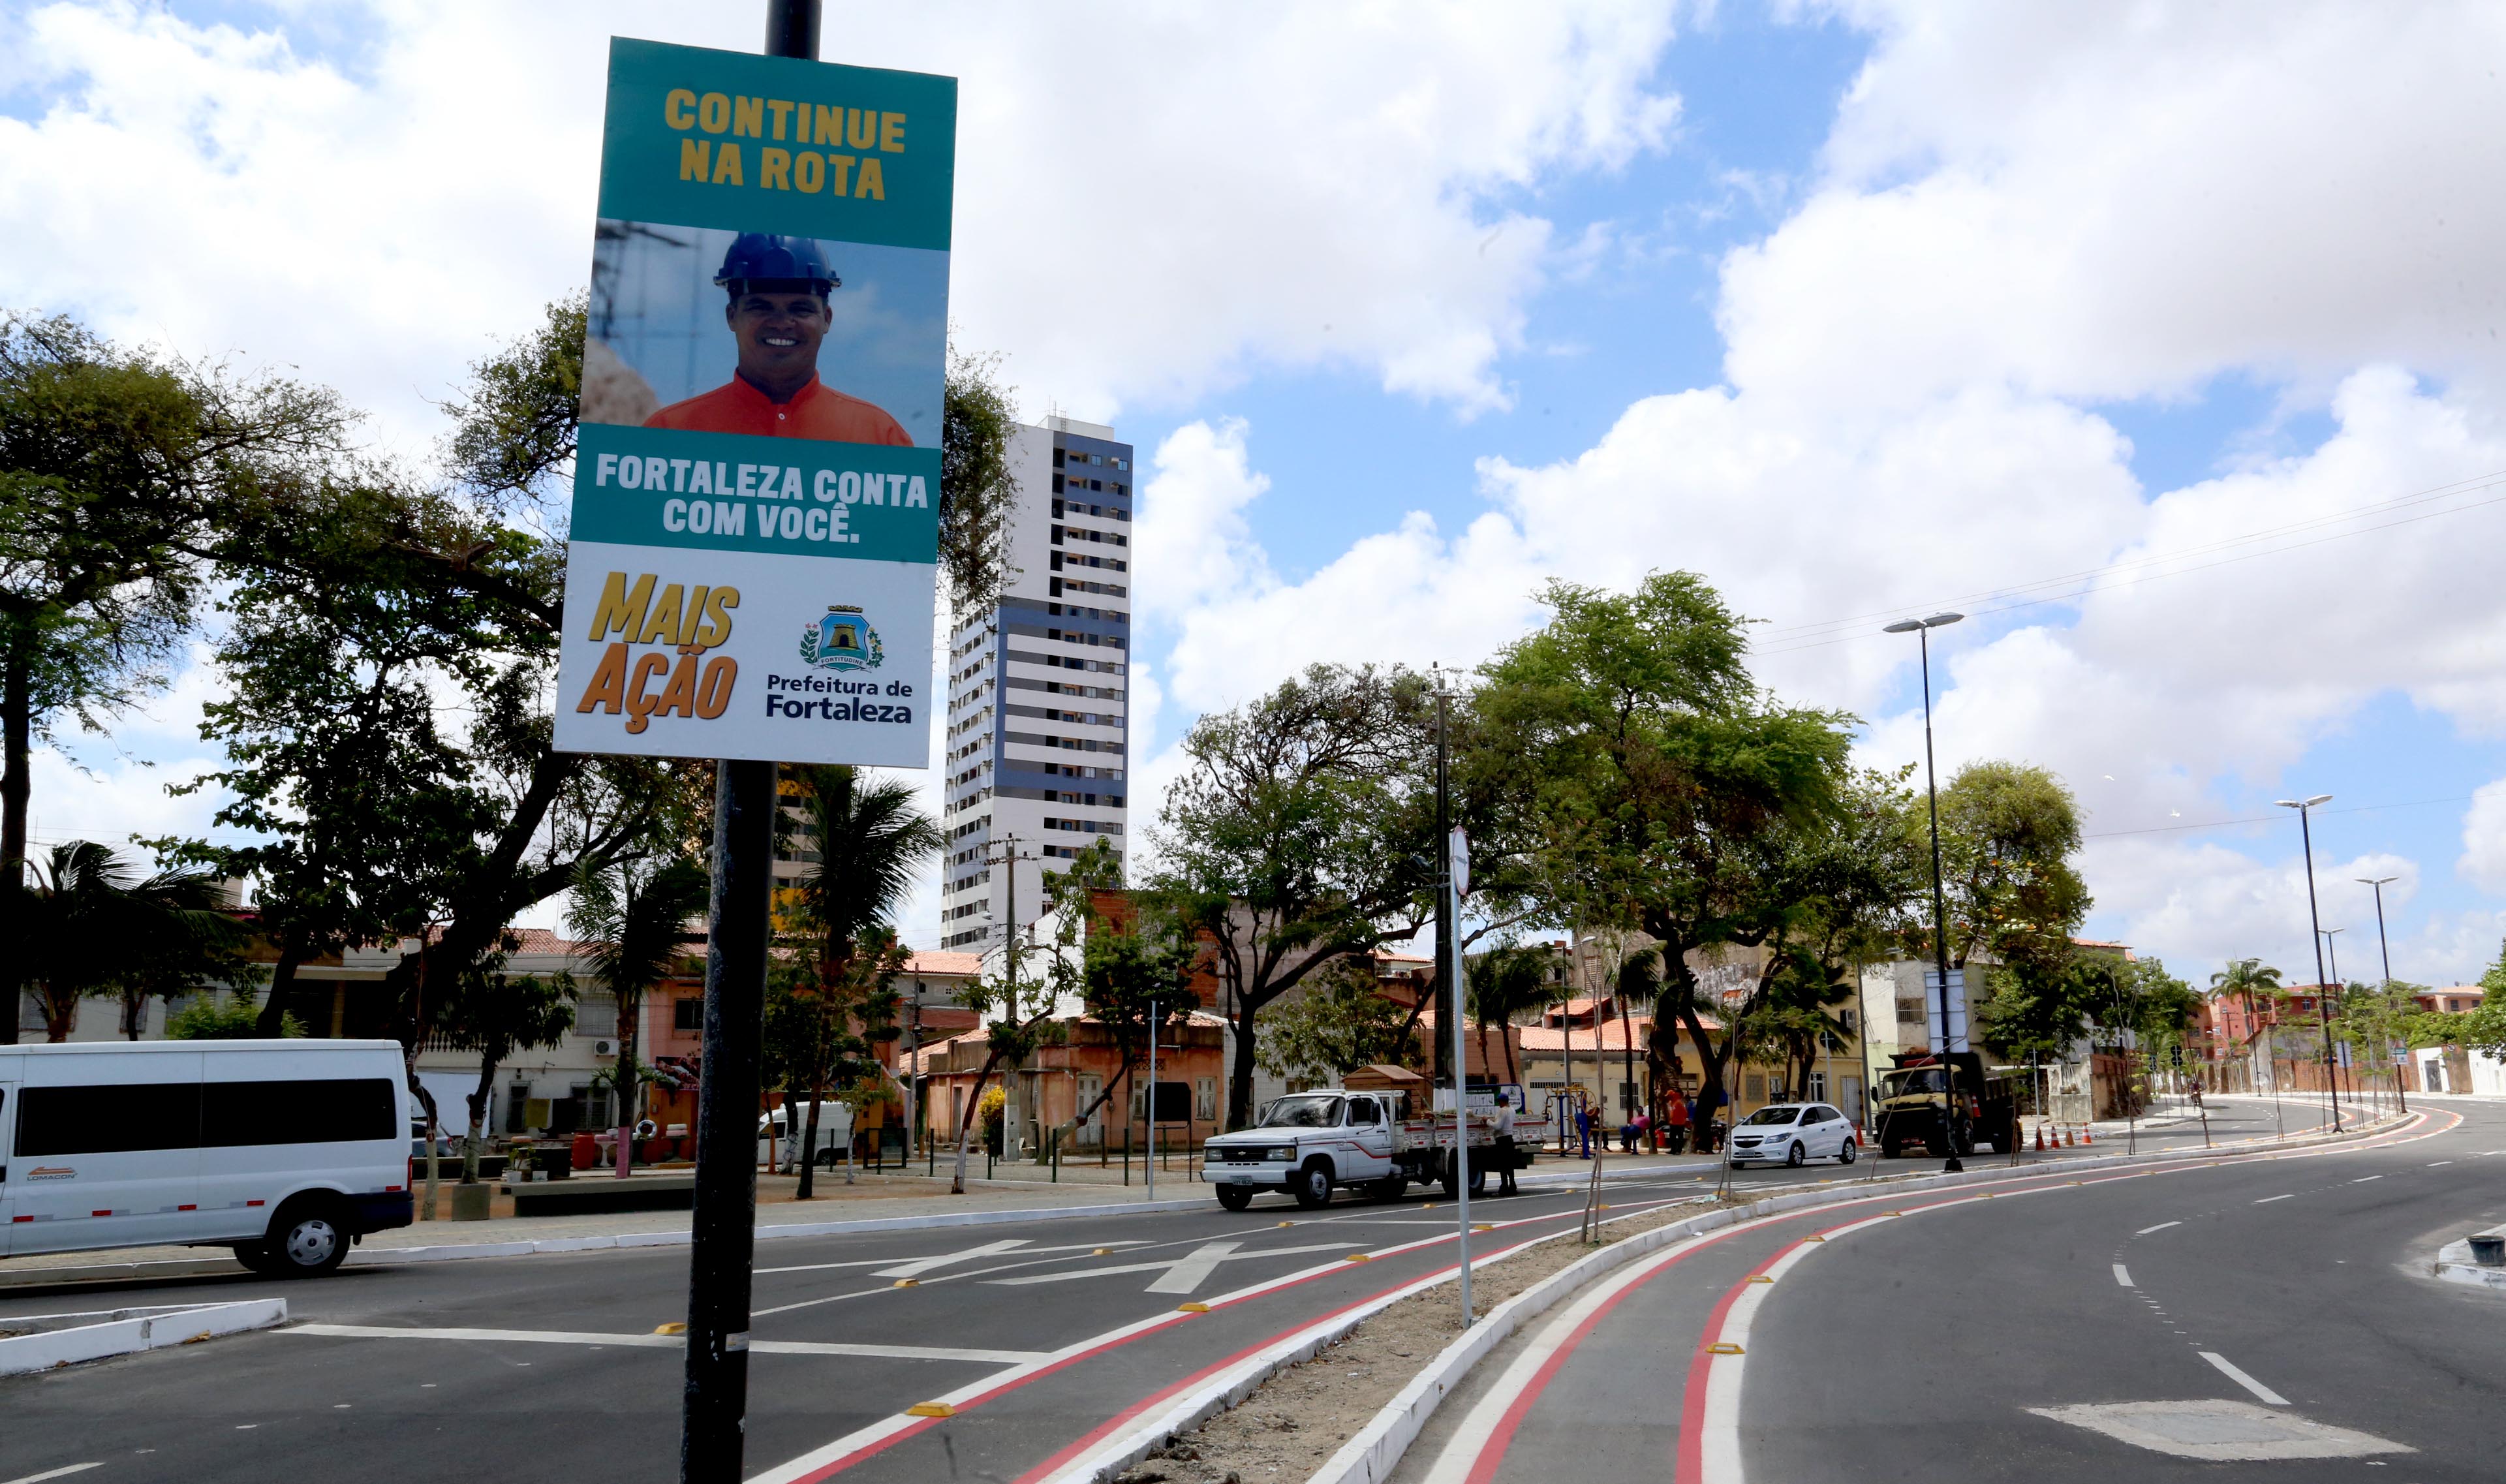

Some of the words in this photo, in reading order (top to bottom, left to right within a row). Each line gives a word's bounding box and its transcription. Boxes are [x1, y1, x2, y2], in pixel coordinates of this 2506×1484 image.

[664, 88, 906, 153] CONTINUE
[679, 139, 744, 186] NA
[760, 147, 886, 201] ROTA
[596, 453, 803, 501] FORTALEZA
[814, 469, 929, 509] CONTA
[663, 499, 746, 536] COM
[757, 502, 859, 544] VOCÊ.
[589, 571, 740, 649] MAIS
[576, 643, 738, 734] AÇÃO
[767, 675, 879, 696] Prefeitura
[886, 680, 913, 698] de
[821, 657, 864, 666] FORTITUDINE
[766, 694, 912, 724] Fortaleza
